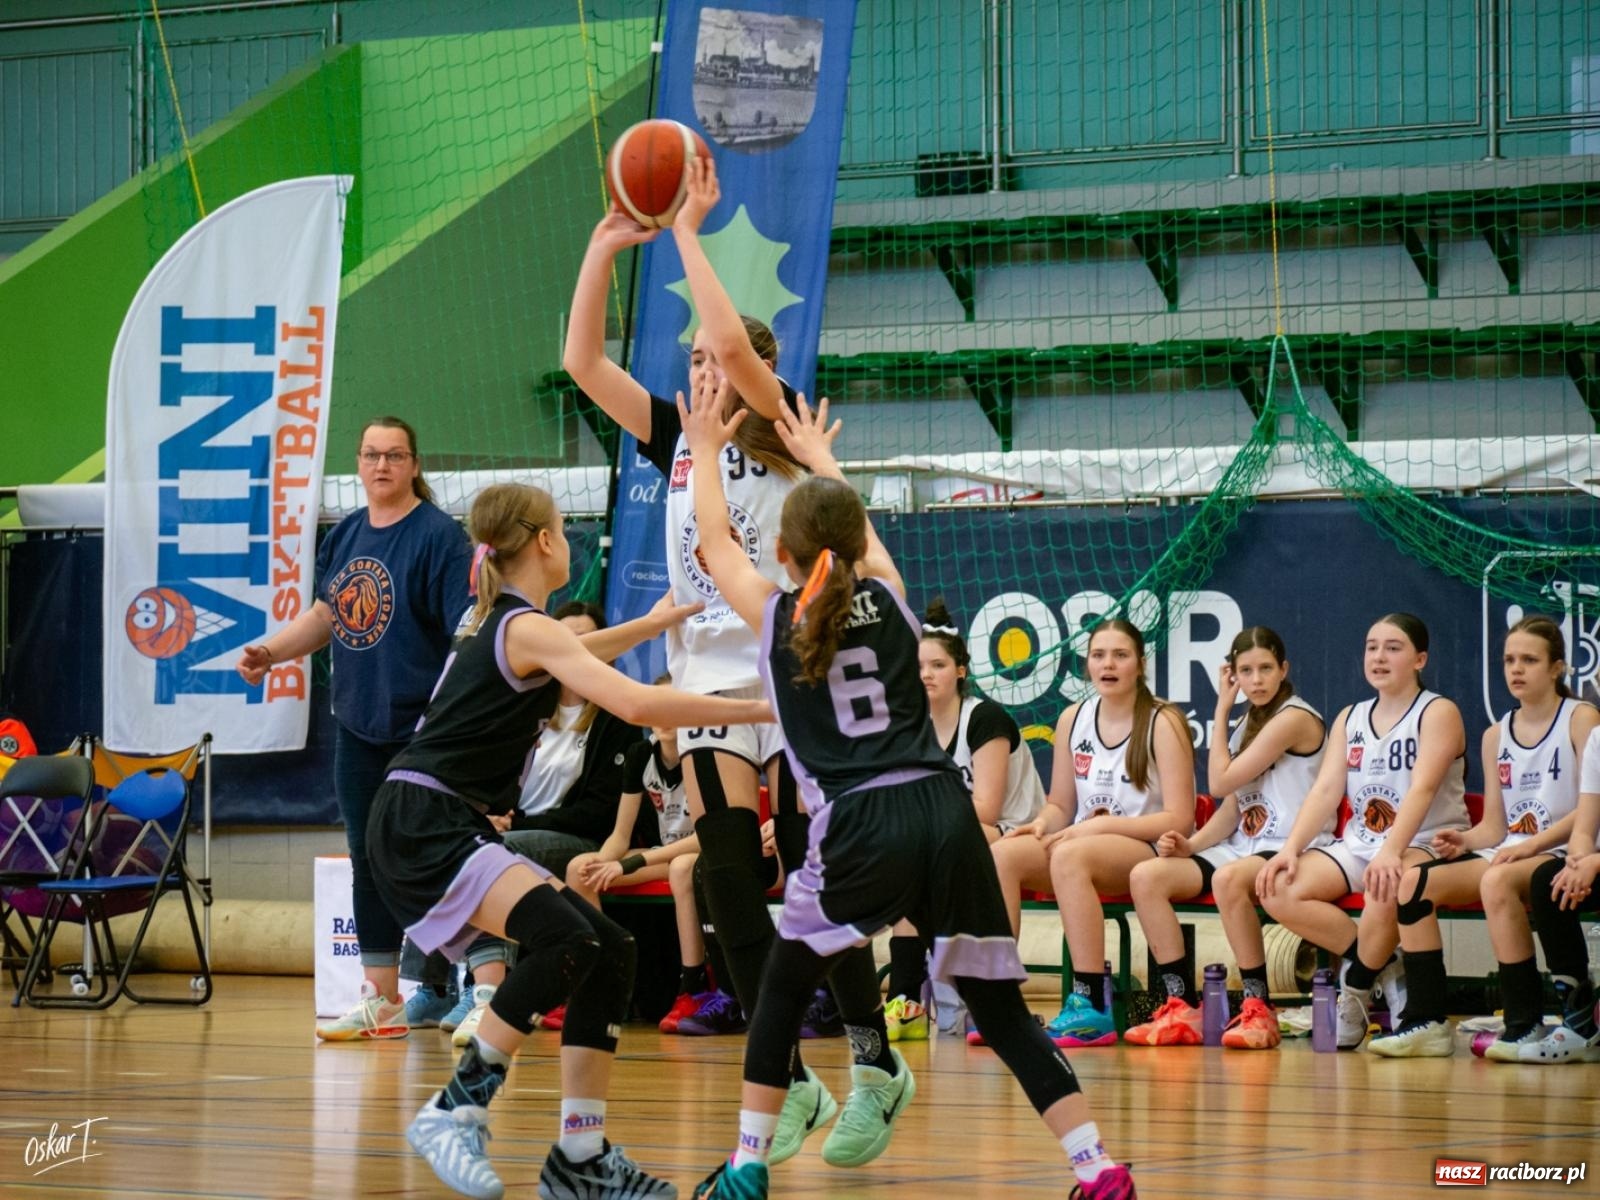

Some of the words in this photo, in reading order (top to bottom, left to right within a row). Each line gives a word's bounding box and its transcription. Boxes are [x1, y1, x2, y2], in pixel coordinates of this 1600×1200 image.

[154, 306, 277, 705] MINI
[267, 306, 326, 704] BSKETBALL
[630, 477, 662, 504] od
[631, 571, 670, 582] racibor
[827, 646, 892, 738] 6
[1389, 737, 1418, 771] 88
[1548, 747, 1561, 781] 4
